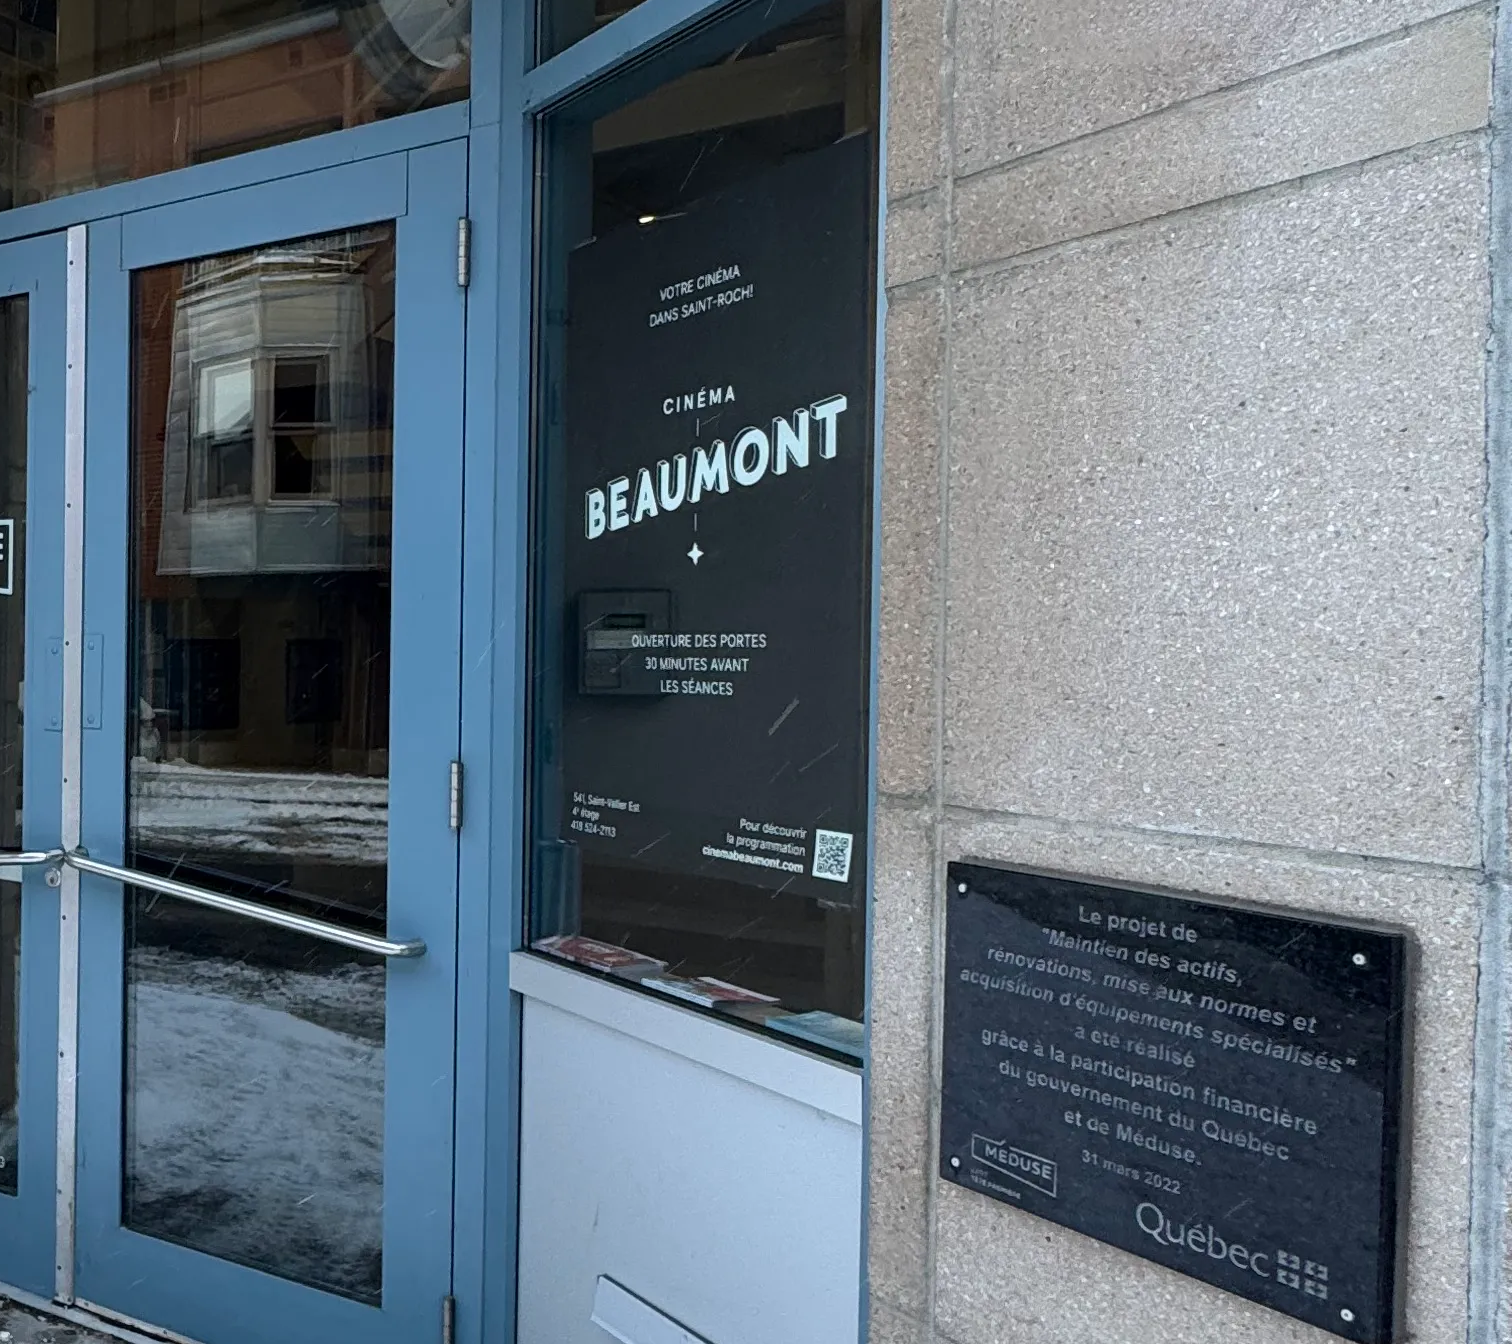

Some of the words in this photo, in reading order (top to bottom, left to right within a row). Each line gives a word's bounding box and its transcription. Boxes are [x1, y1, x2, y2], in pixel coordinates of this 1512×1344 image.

[659, 279, 694, 301] VOTRE
[697, 264, 741, 290] CINÉMA
[649, 307, 679, 327] DANS
[681, 284, 754, 318] SAINT-ROCH!
[663, 385, 735, 415] CINÉMA
[585, 394, 847, 540] BEAUMONT
[631, 634, 692, 648] OUVERTURE
[694, 634, 716, 648] DES
[720, 634, 767, 648] PORTES
[645, 657, 657, 670] 30
[659, 657, 708, 671] MINUTES
[710, 658, 749, 672] AVANT
[660, 680, 679, 693] LES
[681, 677, 733, 695] SÉANCES
[726, 832, 735, 844] la
[735, 836, 806, 857] programmation
[739, 818, 761, 831] Pour
[762, 822, 807, 840] découvrir
[702, 844, 804, 874] cinemabeaumont.com
[1078, 905, 1102, 925] Le
[1107, 914, 1167, 938] projet
[1171, 923, 1198, 943] de
[1134, 949, 1171, 970] des
[1177, 958, 1242, 987] actifs,
[960, 968, 1054, 1003] acquisition
[1059, 992, 1204, 1039] d'équipements
[988, 947, 1097, 986] rénovations,
[1103, 973, 1150, 995] mise
[1156, 984, 1194, 1006] aux
[1199, 995, 1286, 1026] normes
[1293, 1015, 1317, 1034] et
[1074, 1026, 1086, 1040] a
[1126, 1039, 1195, 1068] réalisé
[982, 1029, 1029, 1053] grâce
[1033, 1040, 1045, 1057] à
[1050, 1045, 1066, 1064] la
[1071, 1053, 1195, 1101] participation
[1202, 1086, 1317, 1135] financière
[999, 1060, 1020, 1079] du
[1026, 1069, 1163, 1123] gouvernement
[1168, 1110, 1195, 1132] du
[1201, 1119, 1289, 1160] Québec
[1064, 1109, 1082, 1127] et
[1087, 1117, 1110, 1135] de
[1116, 1123, 1202, 1166] Méduse.
[1081, 1149, 1099, 1165] 31
[1102, 1158, 1140, 1180] mars
[1144, 1171, 1181, 1195] 2022
[1136, 1202, 1270, 1278] Québec
